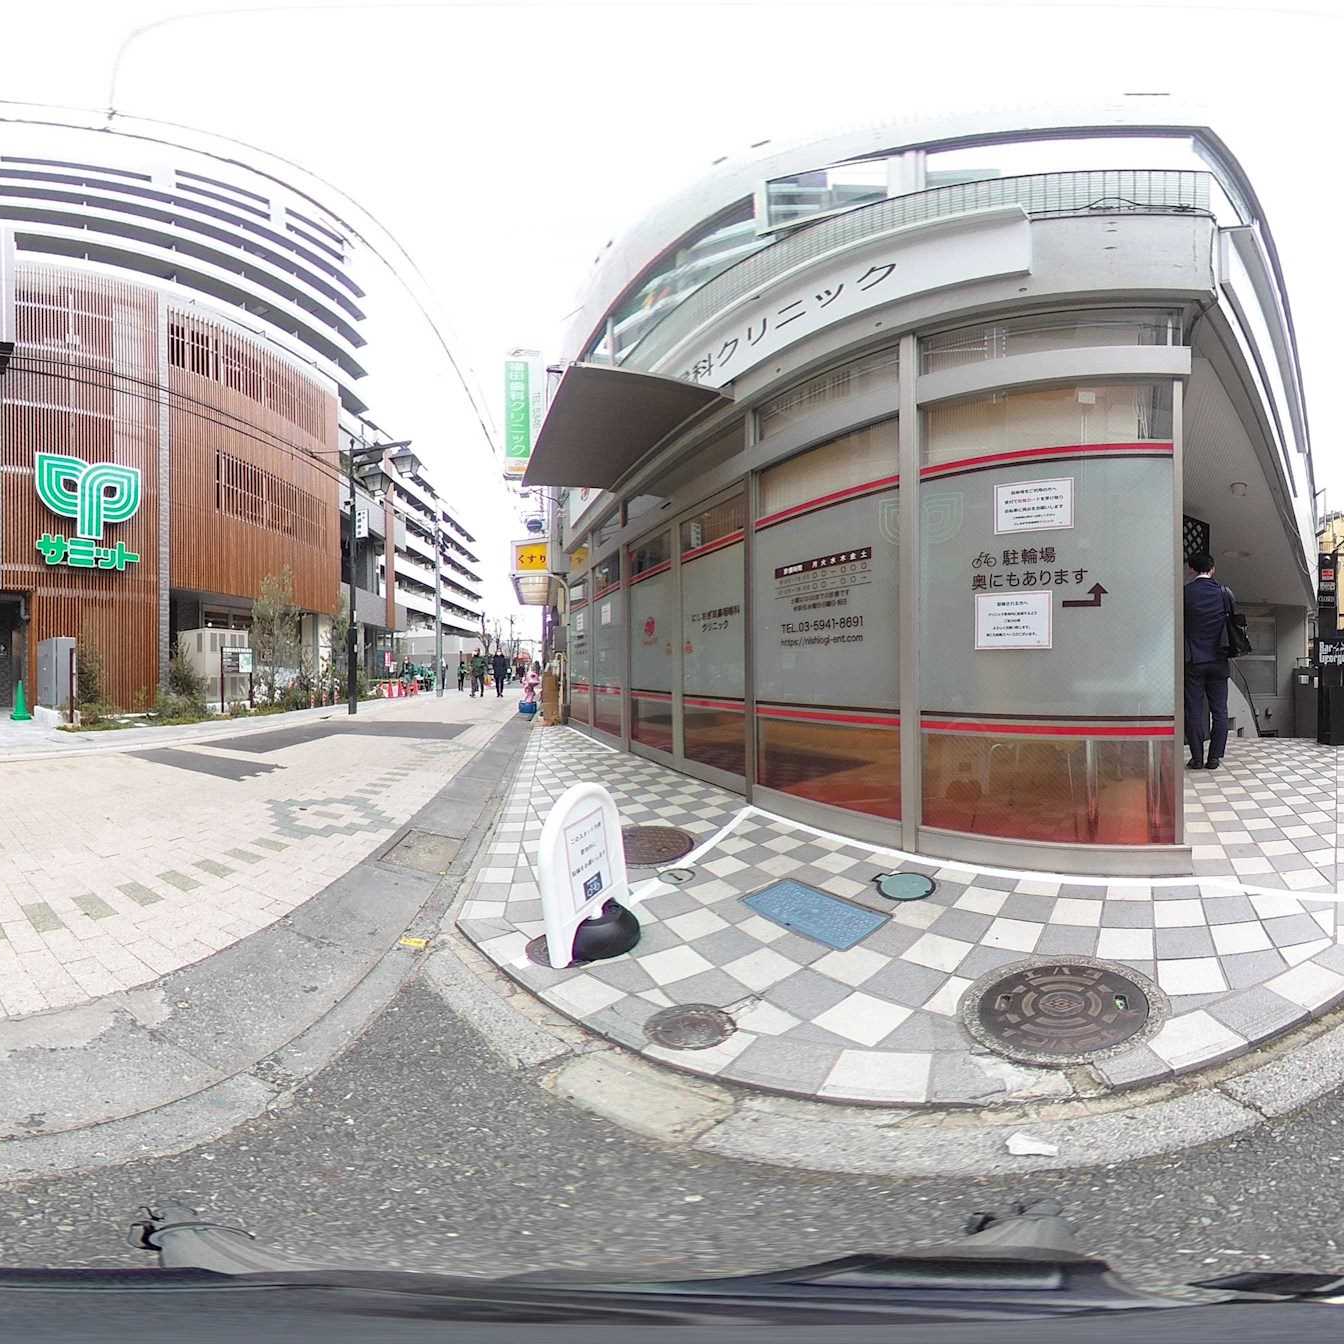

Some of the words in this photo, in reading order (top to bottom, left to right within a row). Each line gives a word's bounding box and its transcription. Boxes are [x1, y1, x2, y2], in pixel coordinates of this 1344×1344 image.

[35, 532, 141, 571] サミット
[518, 553, 546, 564] くすり
[1002, 546, 1057, 566] 駐輪場
[971, 567, 1089, 591] 奥にもあります
